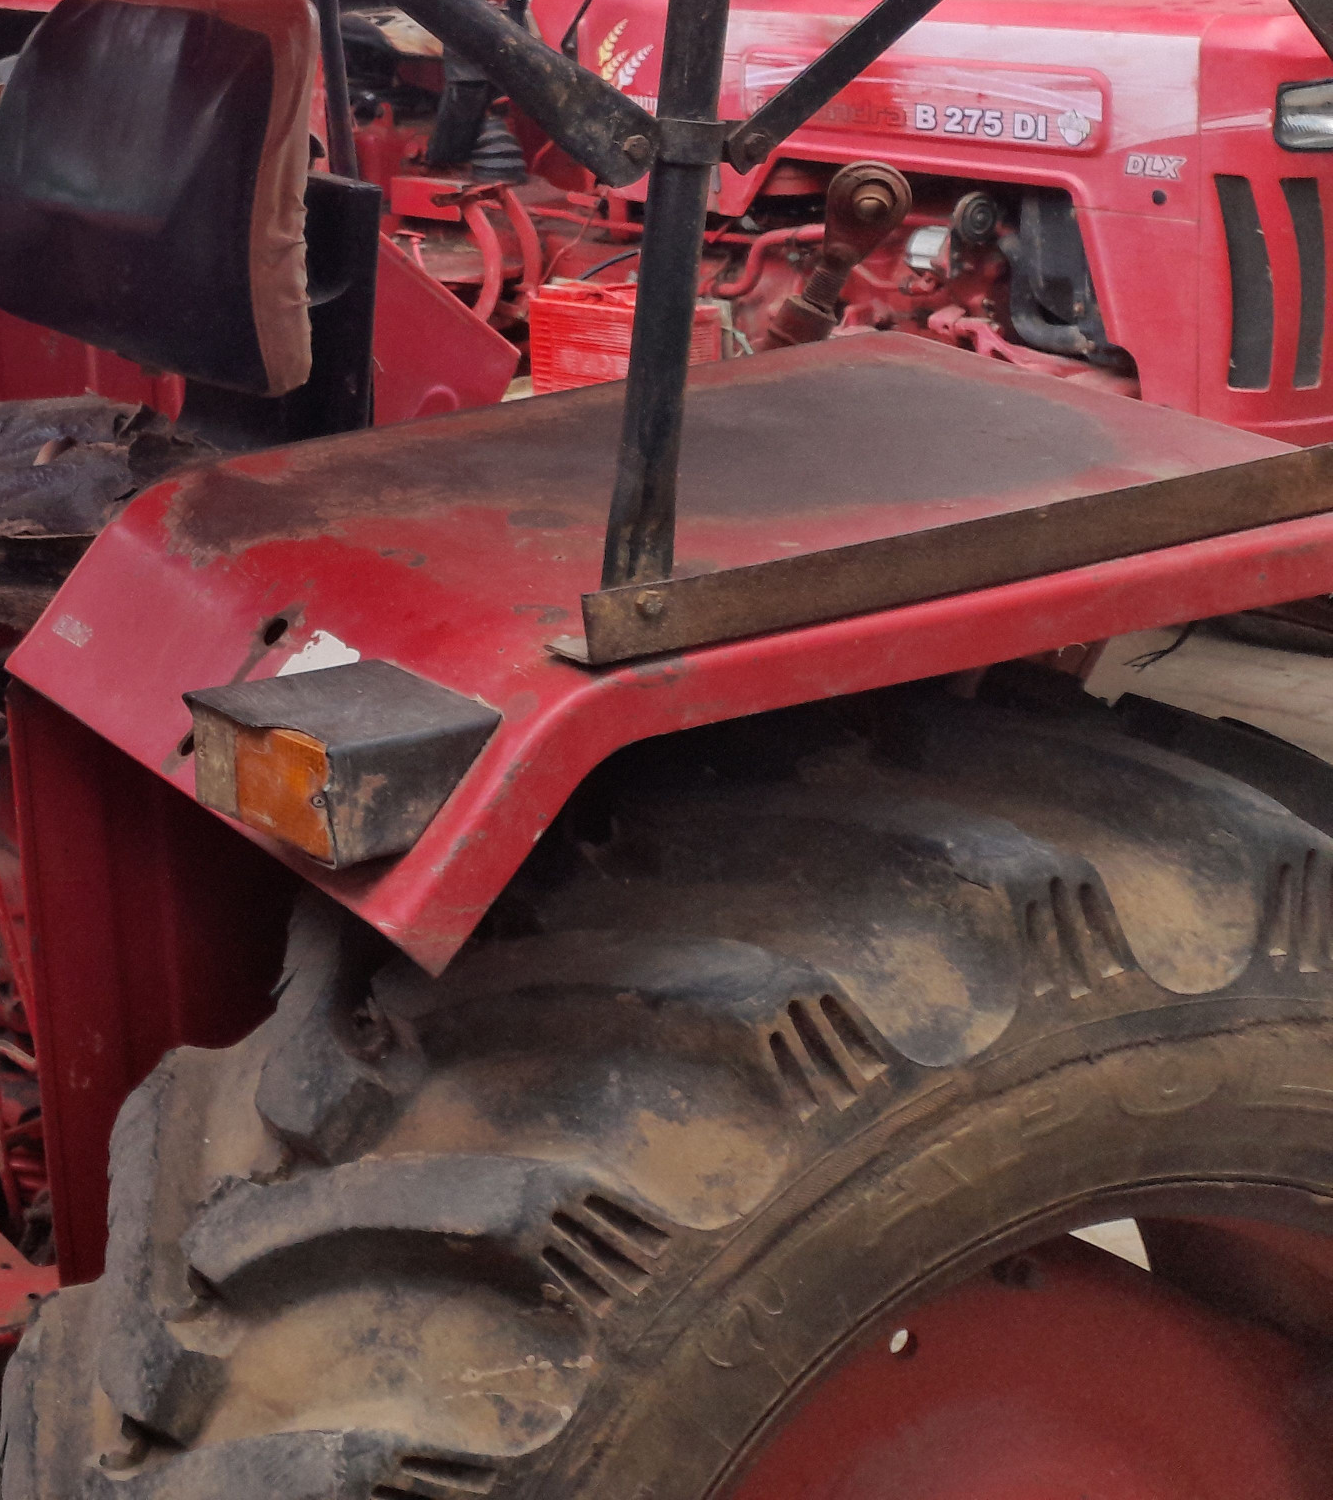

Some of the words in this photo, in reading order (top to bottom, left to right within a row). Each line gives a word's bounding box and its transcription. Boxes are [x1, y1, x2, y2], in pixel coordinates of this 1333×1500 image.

[914, 102, 937, 131] B
[944, 105, 1003, 137] 275
[1013, 112, 1048, 142] DI
[1124, 153, 1187, 180] DLX
